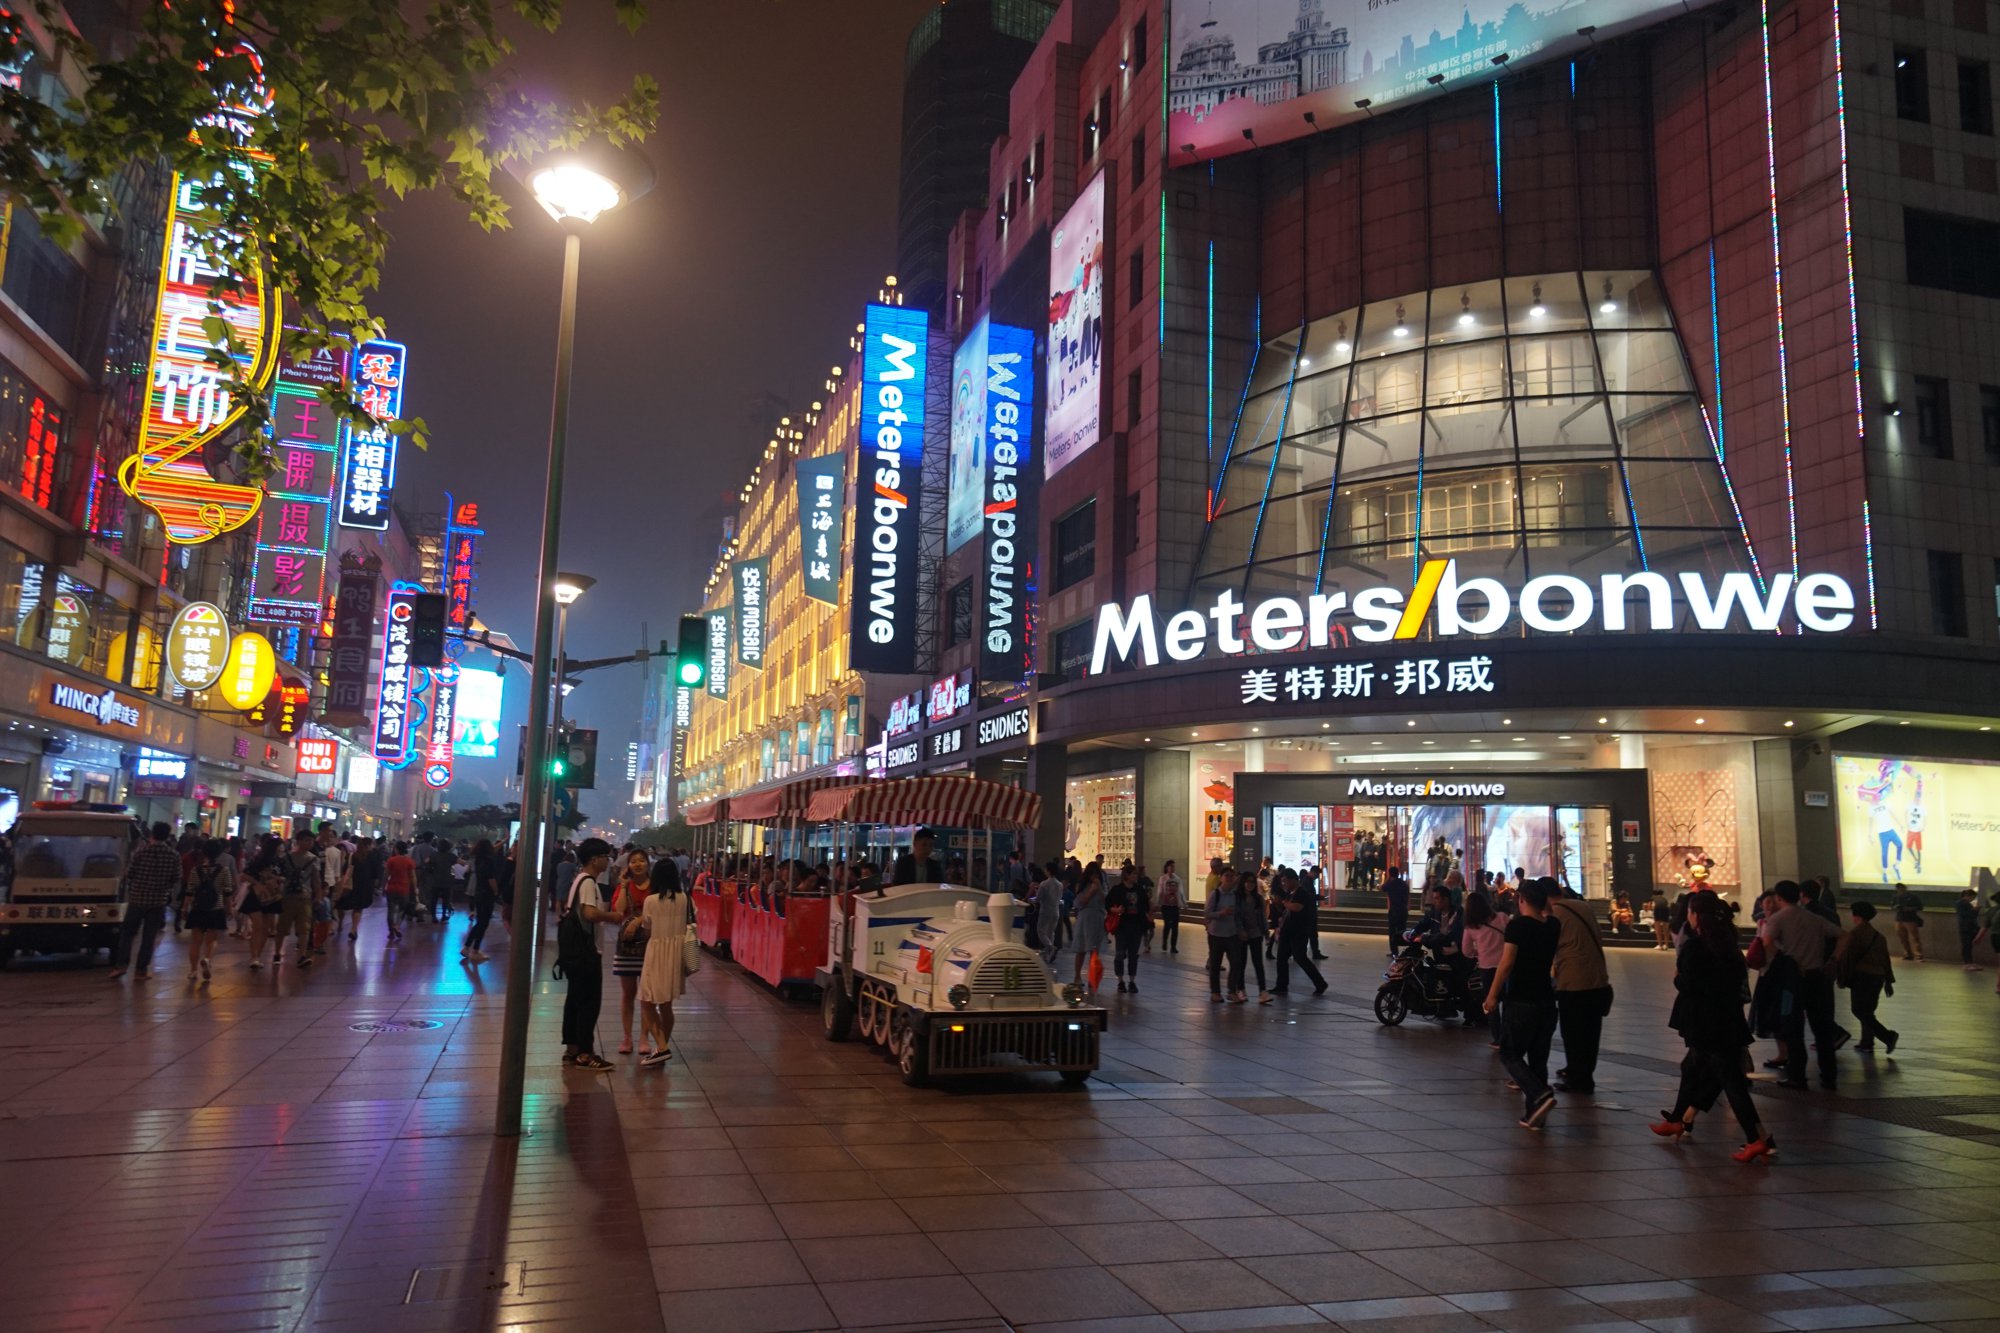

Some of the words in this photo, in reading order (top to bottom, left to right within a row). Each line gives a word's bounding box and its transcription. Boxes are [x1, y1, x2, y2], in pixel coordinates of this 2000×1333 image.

[1371, 39, 1545, 104] 黄浦区精神建设委员办公室
[1403, 39, 1509, 81] 中共黄浦区委宣传部
[868, 332, 918, 644] Meters/bonwe
[1089, 558, 1857, 676] Meters/bonwe
[1239, 654, 1495, 705] 美特斯·邦威
[54, 683, 100, 716] MINGR
[979, 708, 1030, 745] SENDNES
[299, 756, 333, 771] QLO
[301, 741, 332, 757] UNI
[626, 750, 638, 781] FOREVER
[1347, 778, 1506, 797] Meters/bonwe
[873, 941, 885, 955] 11
